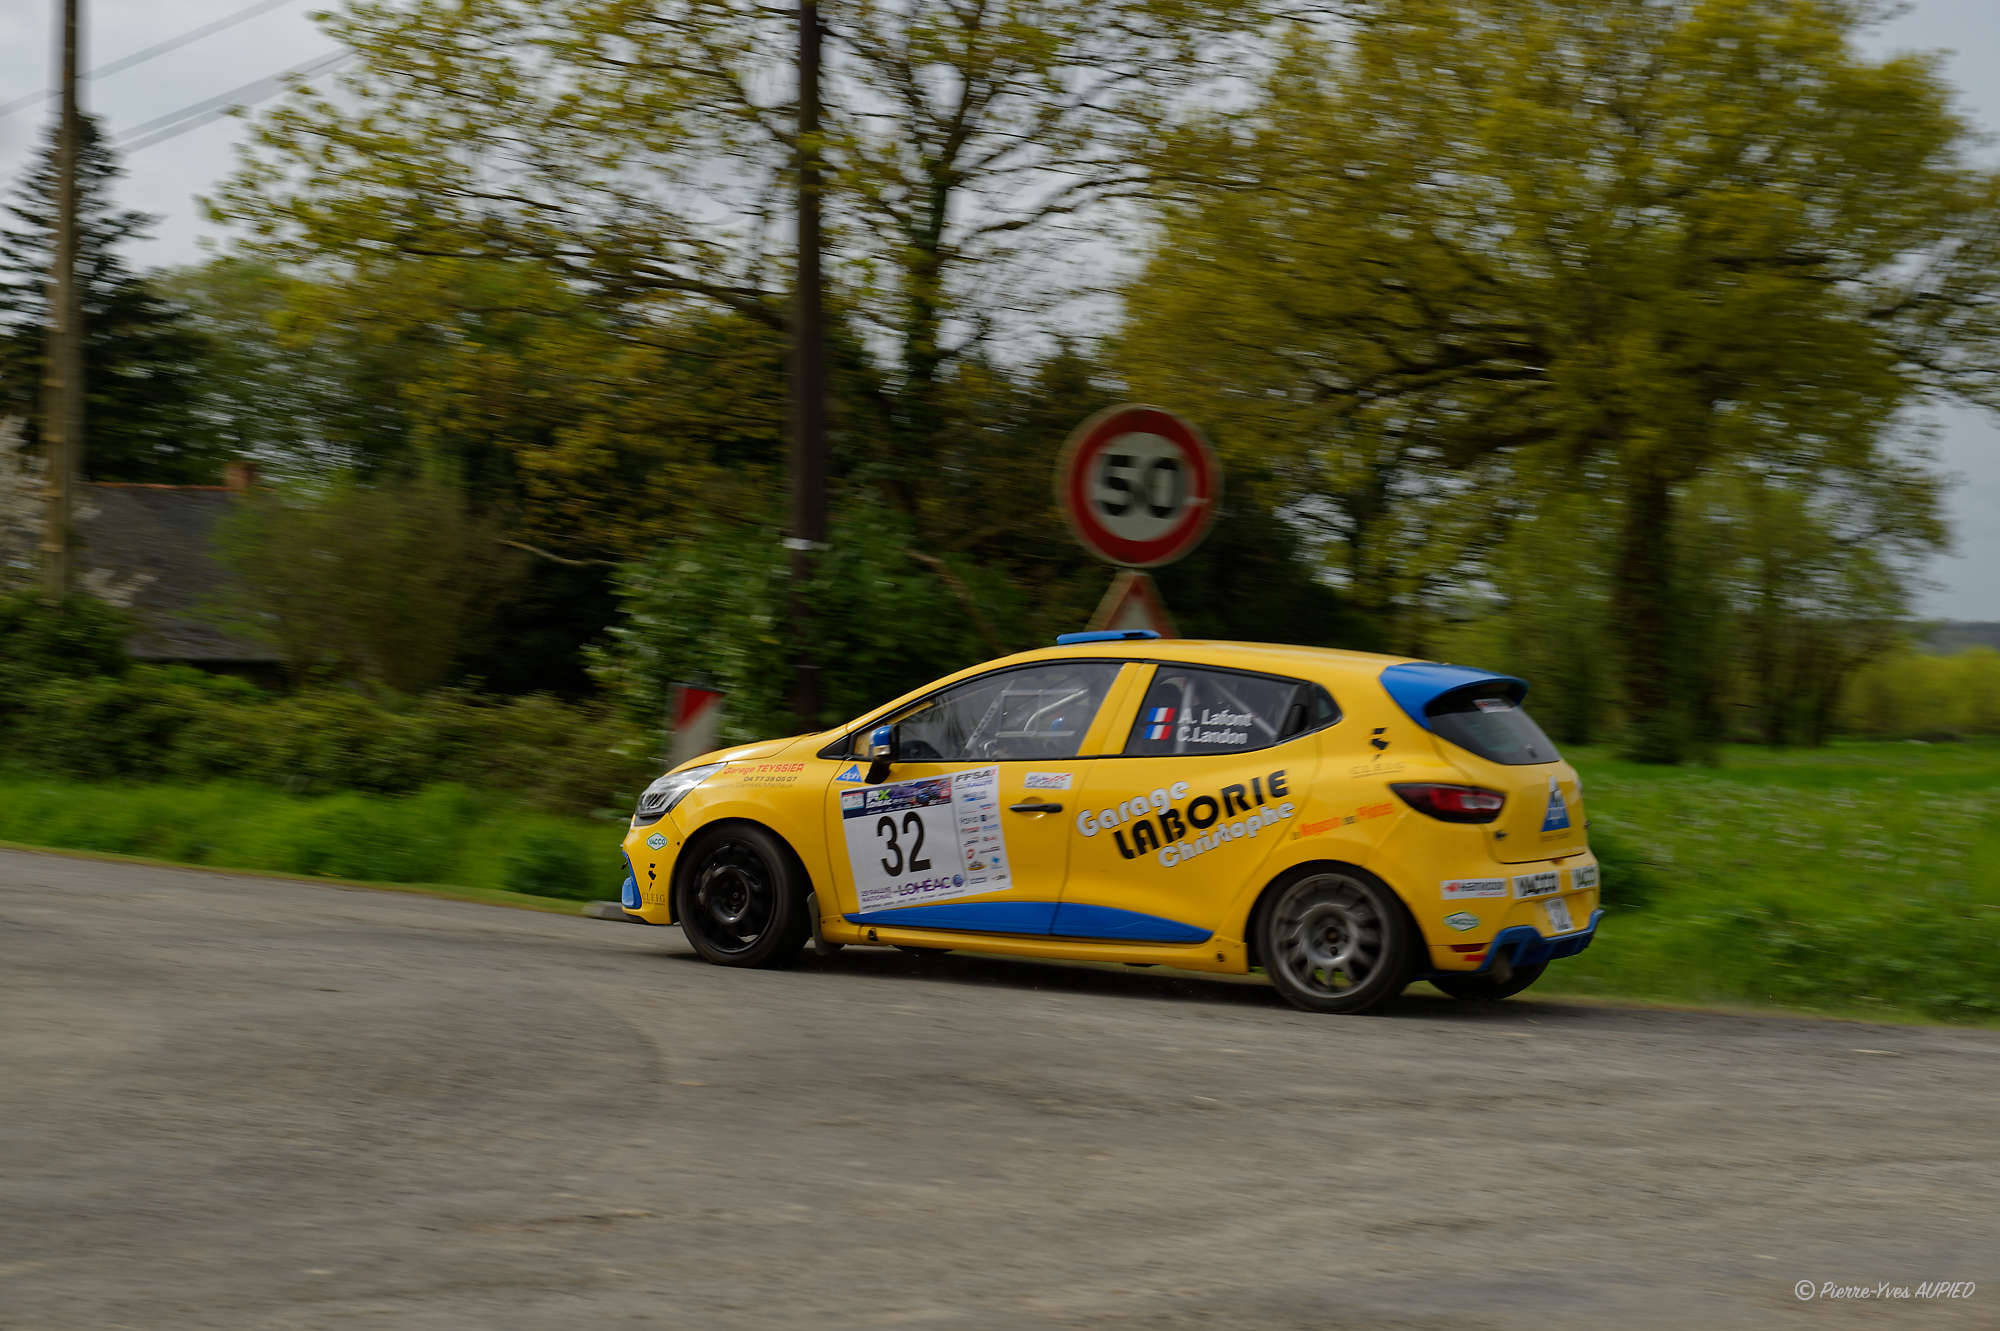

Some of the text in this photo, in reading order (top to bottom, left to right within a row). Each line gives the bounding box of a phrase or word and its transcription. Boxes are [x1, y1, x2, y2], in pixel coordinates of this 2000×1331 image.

[1101, 454, 1185, 518] 50
[1201, 708, 1253, 726] Lafont
[756, 763, 805, 773] TEYSSIER
[1076, 781, 1190, 837] Garage
[1114, 769, 1289, 860] LABORIE
[1158, 802, 1295, 867] Christophe
[877, 811, 932, 877] 32
